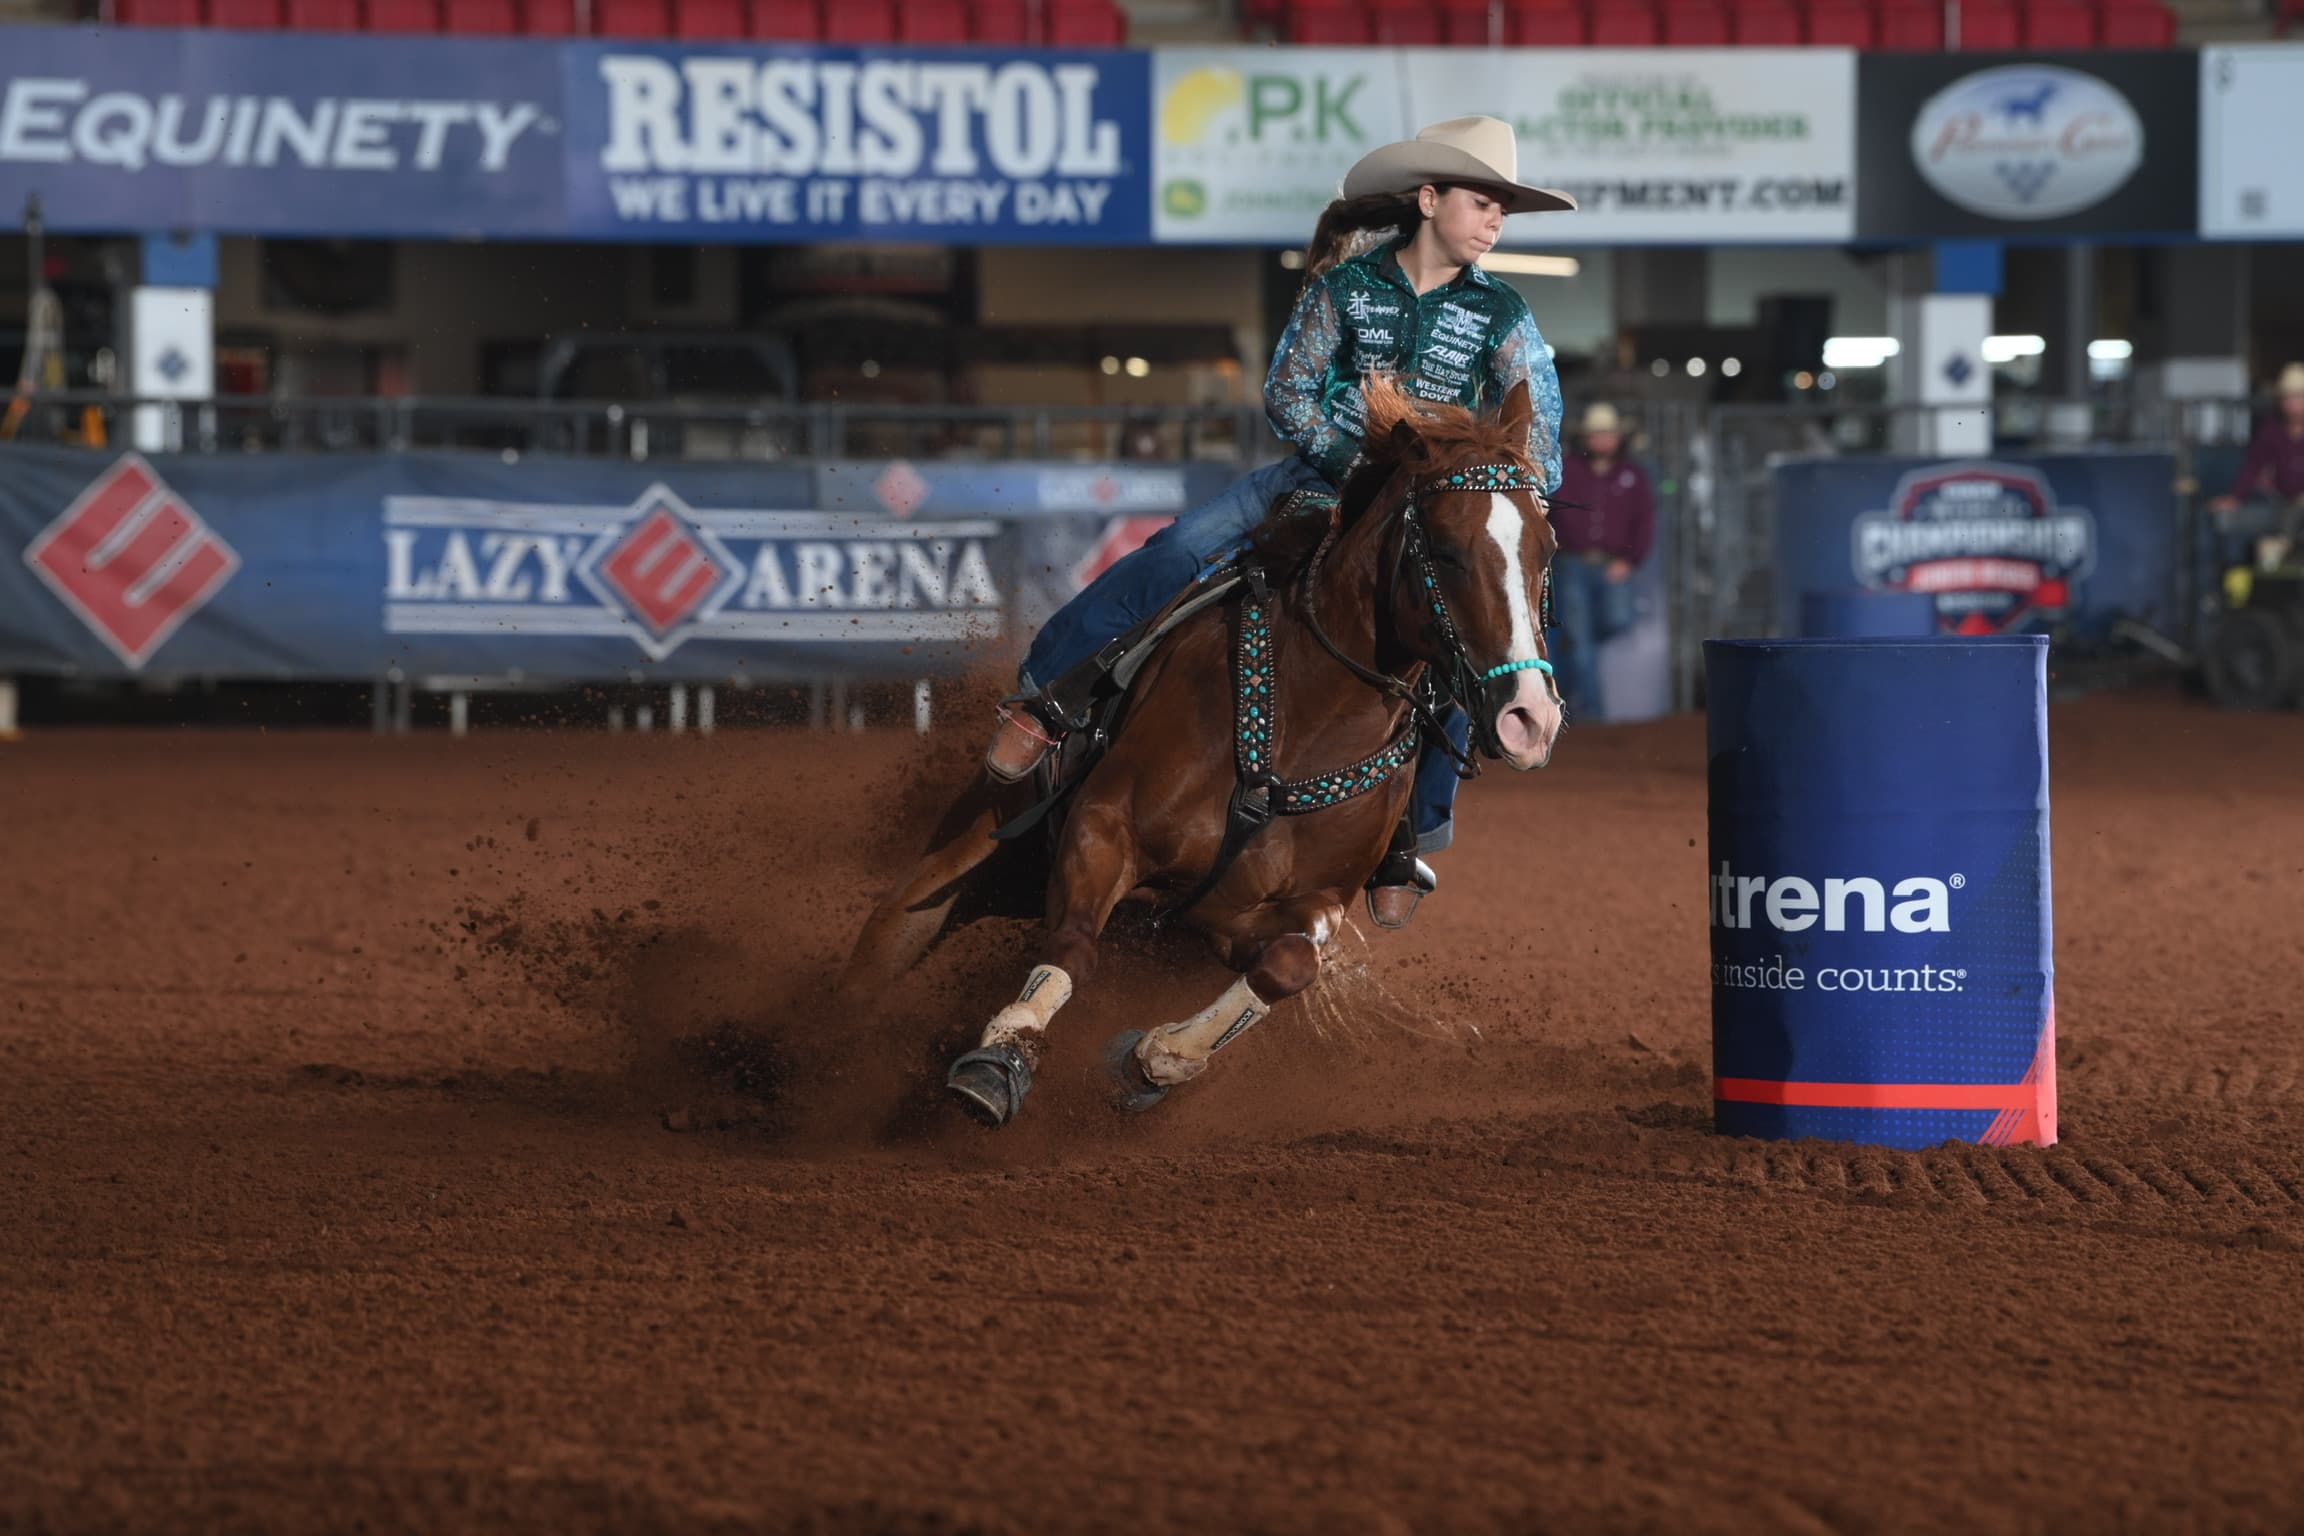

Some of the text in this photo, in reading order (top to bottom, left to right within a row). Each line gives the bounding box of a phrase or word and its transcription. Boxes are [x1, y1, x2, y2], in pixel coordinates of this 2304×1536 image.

[601, 56, 1121, 176] RESISTOL
[609, 178, 1111, 224] WE LIVE IT EVERY DAY
[1417, 345, 1470, 367] FLAIR
[1431, 328, 1483, 353] EQUINETY
[1416, 377, 1462, 398] WESTERN
[385, 529, 583, 602] LAZY
[743, 540, 999, 609] ARENA
[1723, 954, 1806, 991] inside
